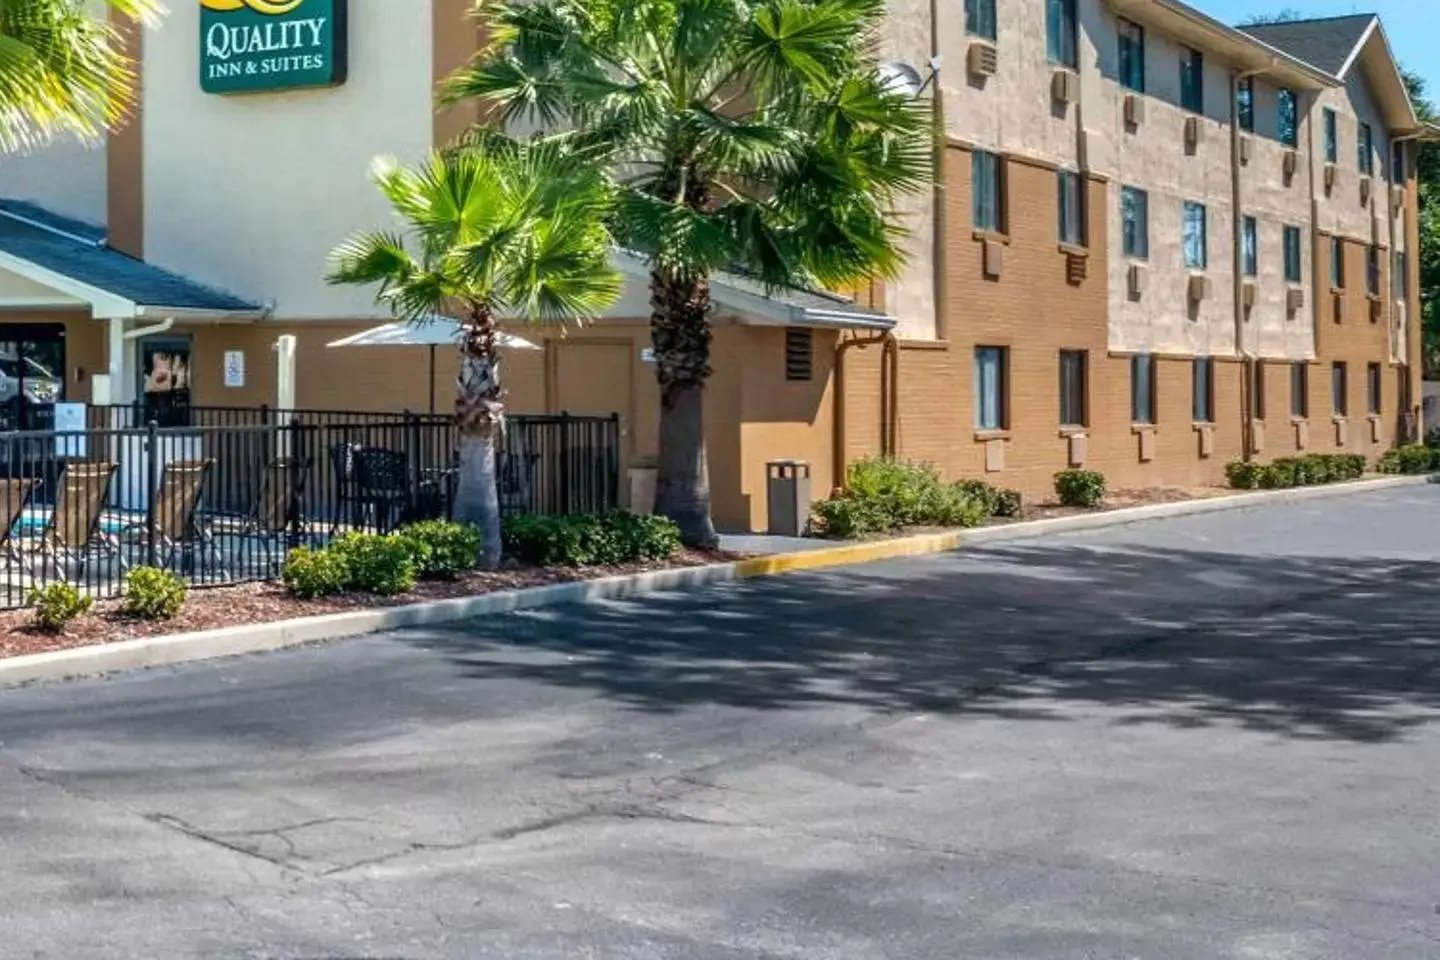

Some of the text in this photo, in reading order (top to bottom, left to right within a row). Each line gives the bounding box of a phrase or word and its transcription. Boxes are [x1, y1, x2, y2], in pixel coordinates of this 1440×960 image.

[206, 18, 326, 59] QUALITY
[208, 53, 324, 78] INN & SUITES
